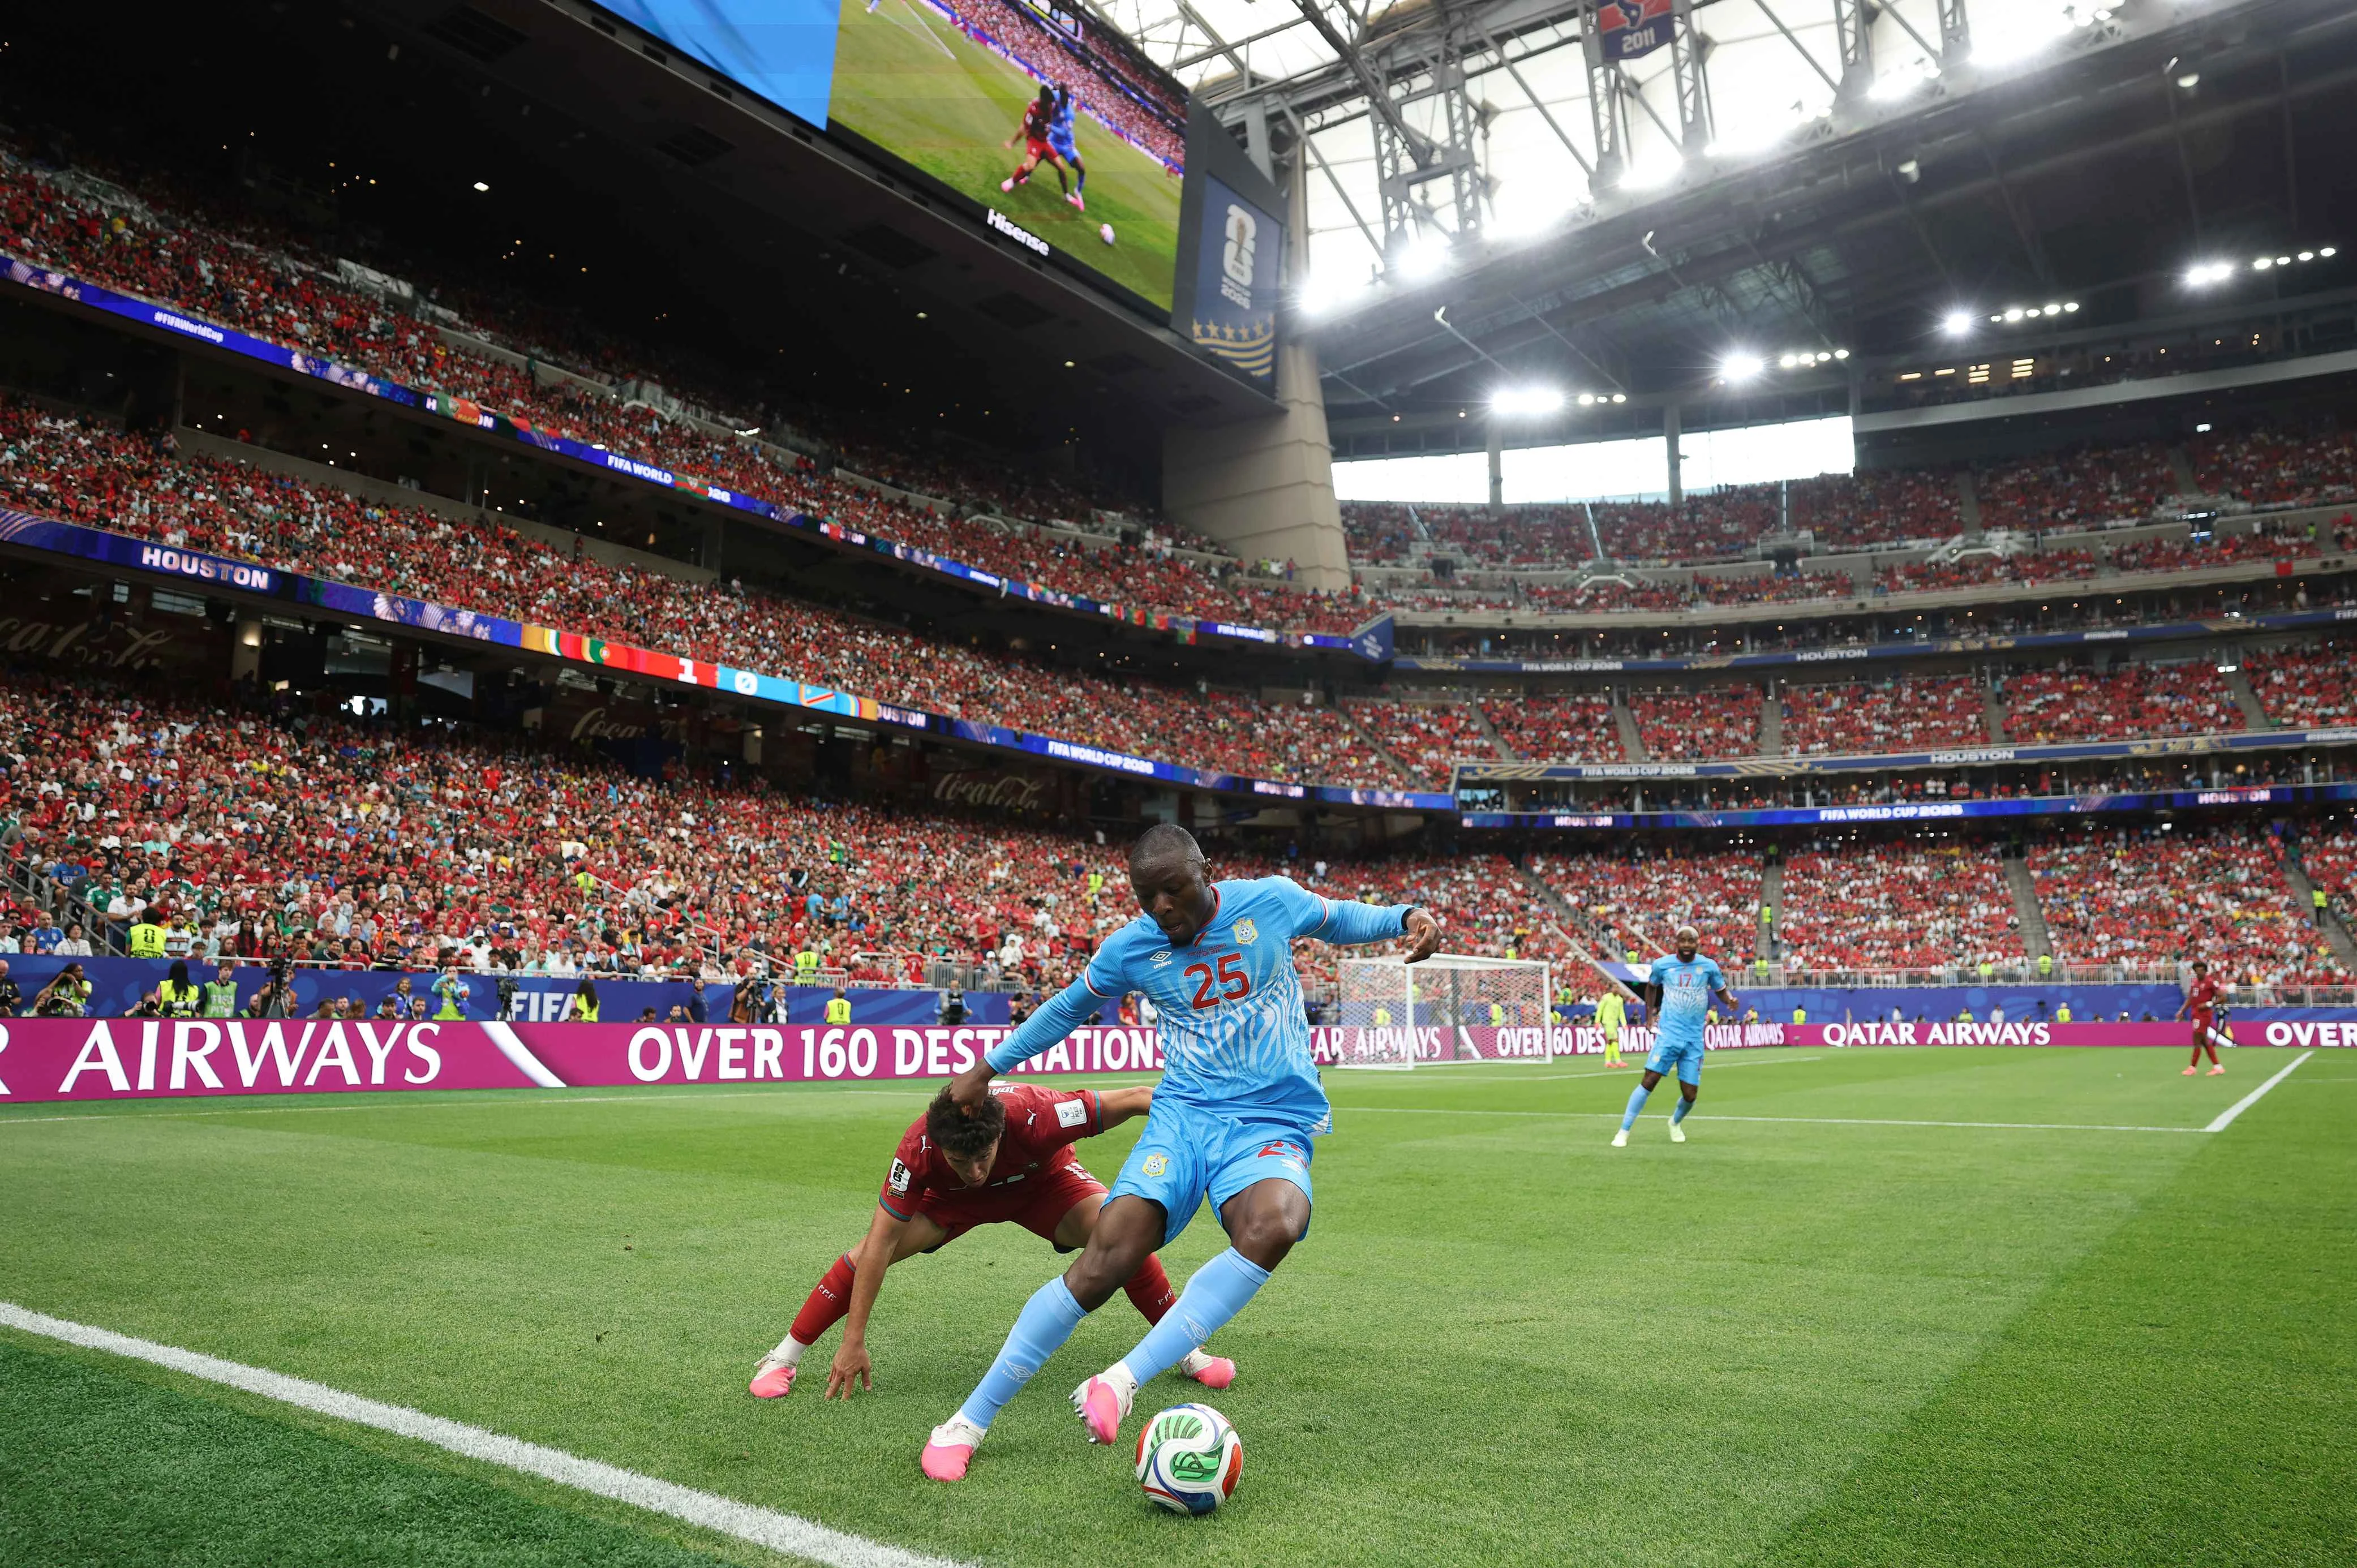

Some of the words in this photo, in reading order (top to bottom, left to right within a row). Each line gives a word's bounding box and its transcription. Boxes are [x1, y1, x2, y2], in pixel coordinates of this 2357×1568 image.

[1622, 27, 1656, 54] 2011
[987, 208, 1049, 256] Hisense
[154, 311, 224, 343] #FIFAWorldCup
[607, 454, 632, 472] FIFA
[633, 462, 672, 484] WORLD
[142, 546, 269, 589] HOUSTON
[1522, 663, 1540, 672] FIFA
[1540, 663, 1573, 672] WORLD
[1574, 661, 1591, 671] CUP
[1592, 661, 1624, 671] 2026
[1796, 648, 1867, 661] HOUSTON
[678, 658, 697, 684] 1
[735, 671, 758, 696] 0
[1048, 741, 1070, 757] FIFA
[1070, 745, 1104, 764] WORLD
[1104, 753, 1123, 767] CUP
[1123, 757, 1154, 775] 2026
[1930, 750, 2015, 763] HOUSTON
[1582, 767, 1604, 776] FIFA
[1604, 767, 1640, 776] WORLD
[1640, 766, 1661, 776] CUP
[1662, 766, 1696, 775] 2026
[1254, 781, 1304, 797] HOUSTON
[2198, 790, 2271, 804] HOUSTON
[1555, 816, 1613, 827] HOUSTON
[1820, 809, 1847, 821] FIFA
[1847, 807, 1891, 820] WORLD
[1892, 806, 1918, 818] CUP
[1919, 804, 1964, 817] 2026
[1153, 960, 1172, 969] umbro
[1183, 952, 1250, 1010] 25
[1679, 973, 1692, 987] 17
[1496, 1027, 1544, 1057] OVER
[1705, 1024, 1742, 1051] QATAR
[1744, 1023, 1784, 1047] AIRWAYS
[1823, 1023, 1917, 1048] QATAR
[1926, 1022, 2051, 1046] AIRWAYS
[2266, 1021, 2357, 1047] OVER
[58, 1020, 442, 1093] AIRWAYS
[628, 1026, 784, 1082] OVER
[800, 1028, 878, 1077] 160
